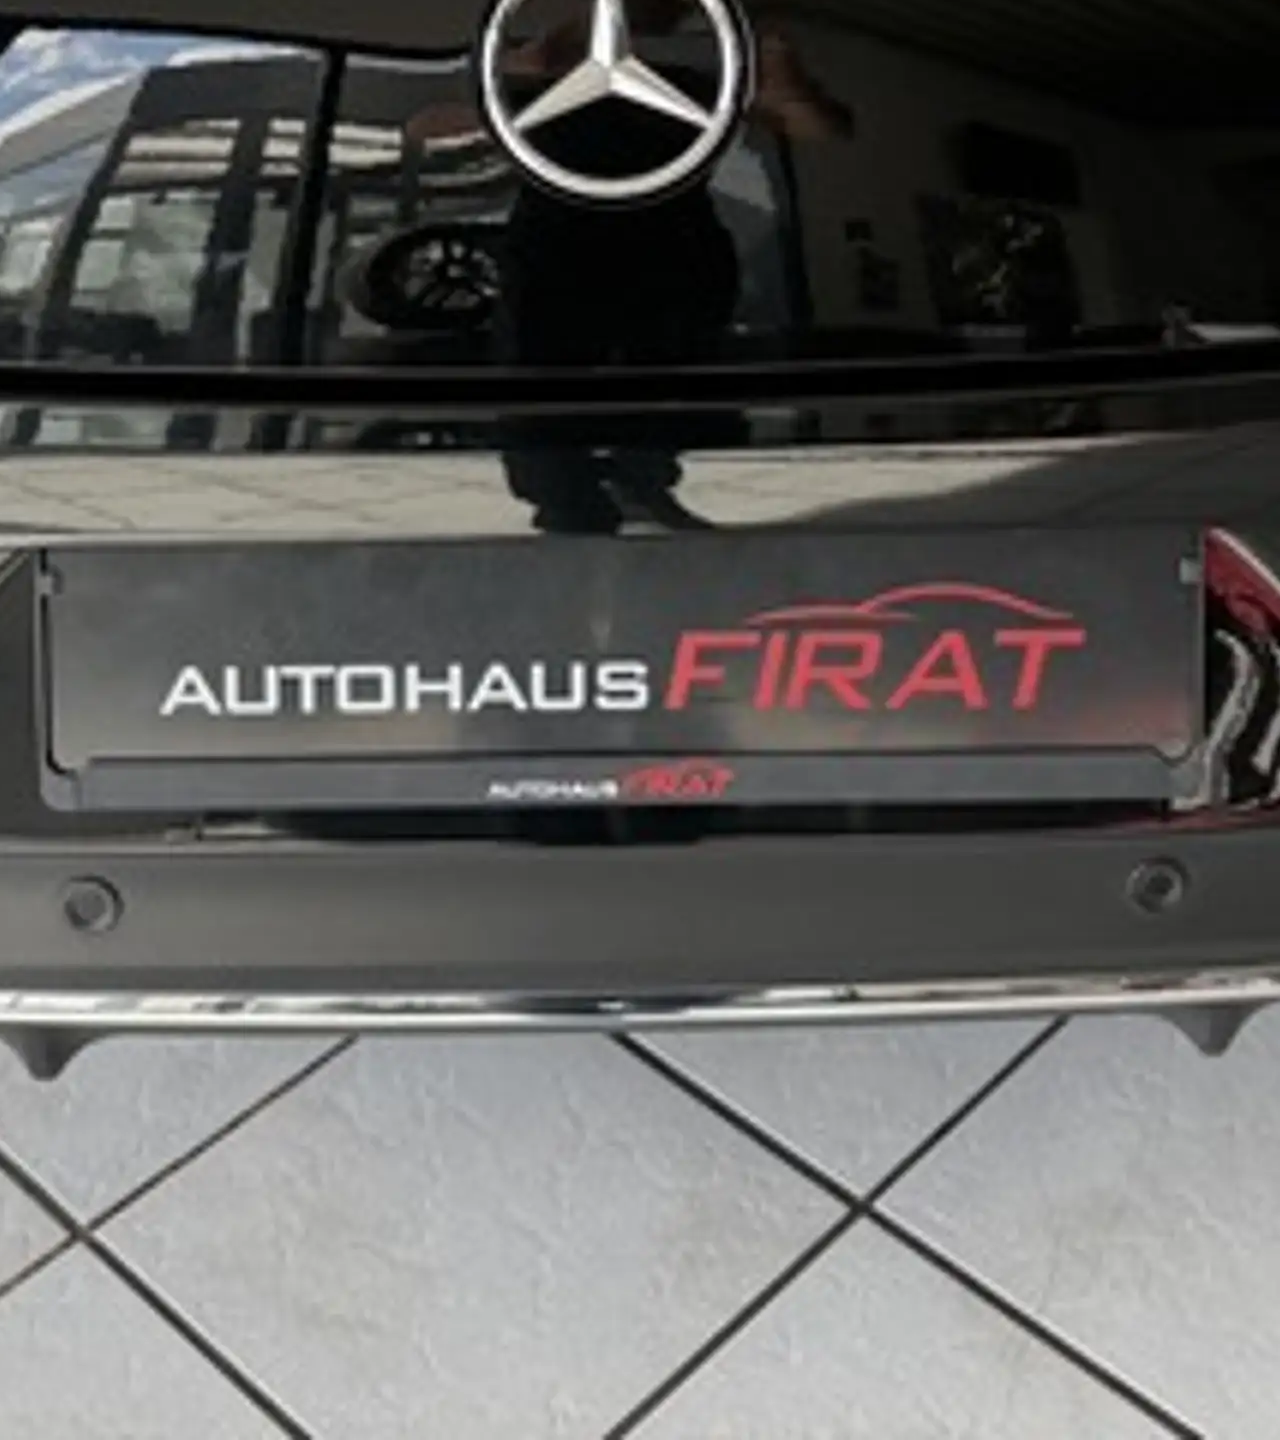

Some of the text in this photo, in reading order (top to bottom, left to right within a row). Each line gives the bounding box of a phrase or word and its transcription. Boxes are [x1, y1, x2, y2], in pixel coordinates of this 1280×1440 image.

[158, 627, 1085, 717] AUTOHAUS FIRAT
[487, 779, 620, 800] AUTOHAUS
